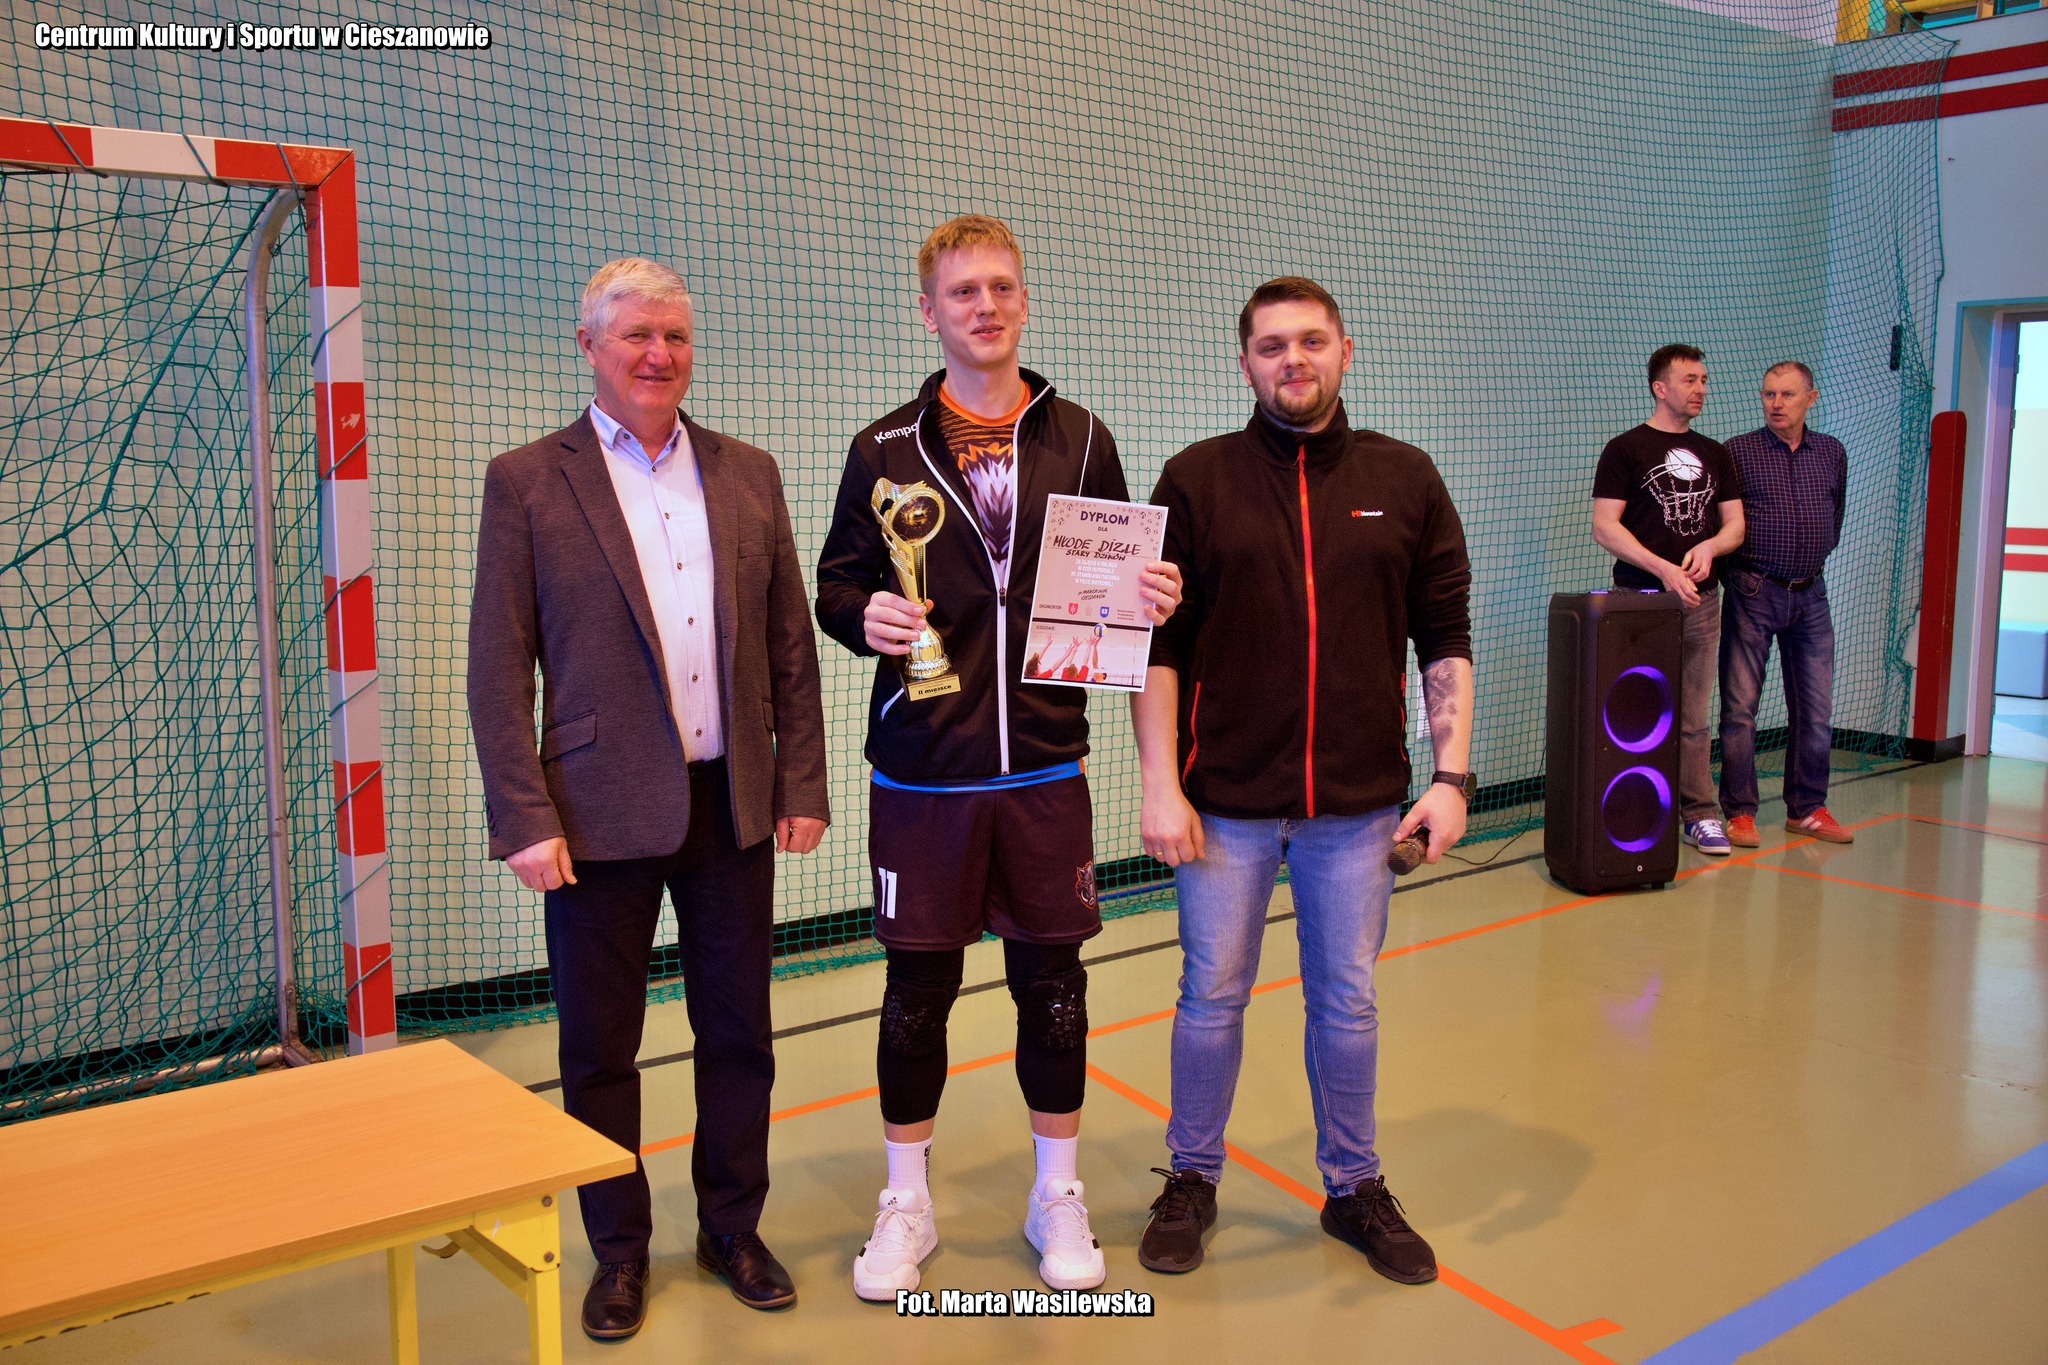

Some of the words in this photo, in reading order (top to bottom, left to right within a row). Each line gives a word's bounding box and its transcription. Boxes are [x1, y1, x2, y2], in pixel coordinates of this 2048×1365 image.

[1080, 511, 1130, 526] DYPLOM
[1053, 535, 1093, 550] MŁODE
[1065, 549, 1091, 557] STARY
[878, 867, 897, 919] 11
